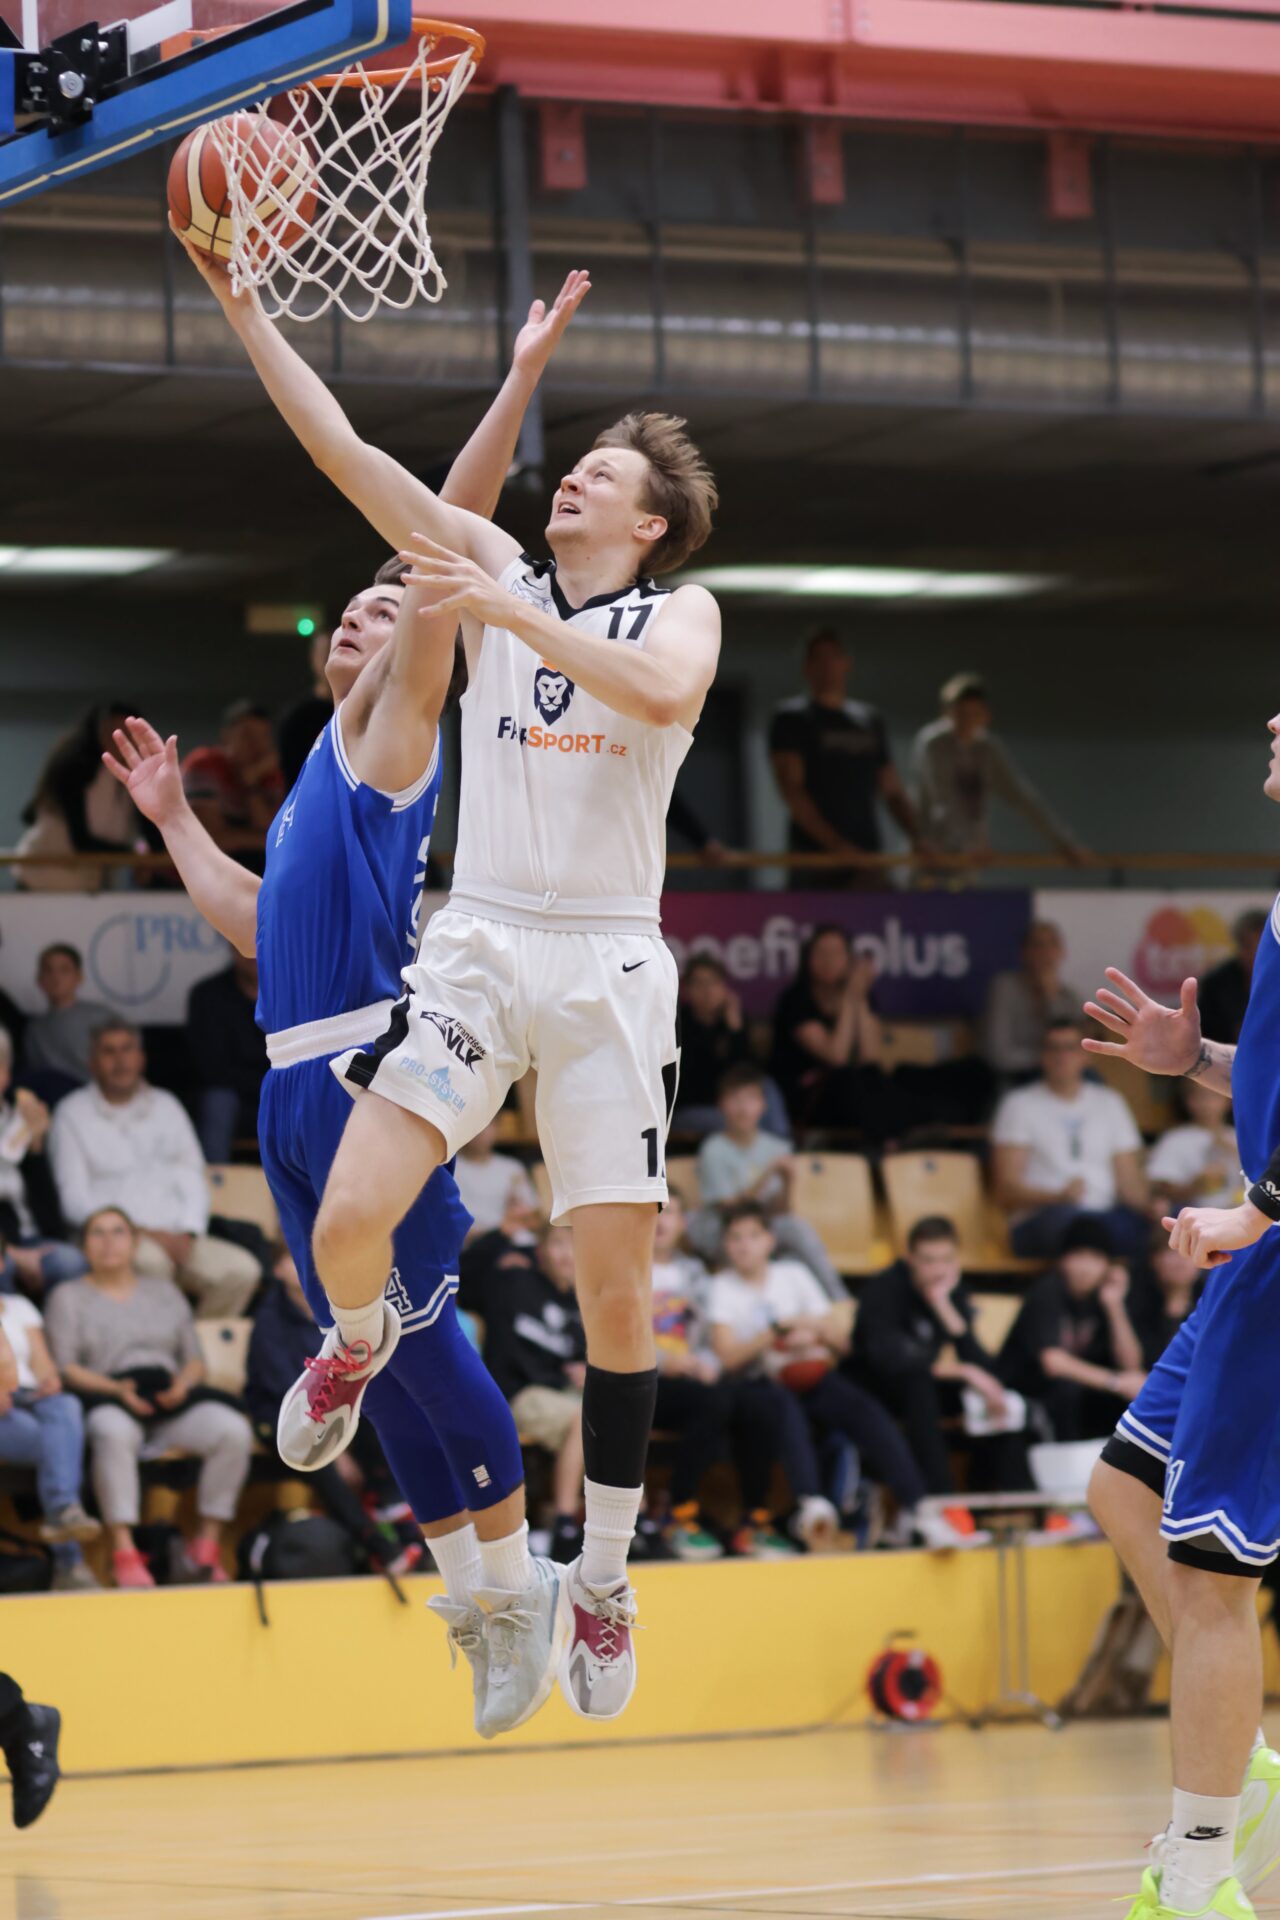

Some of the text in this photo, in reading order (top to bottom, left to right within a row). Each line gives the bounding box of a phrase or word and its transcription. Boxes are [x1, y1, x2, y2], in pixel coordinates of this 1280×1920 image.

[606, 603, 654, 641] 17
[446, 1026, 484, 1075] VLK
[454, 1020, 487, 1057] František
[641, 1127, 665, 1179] 1
